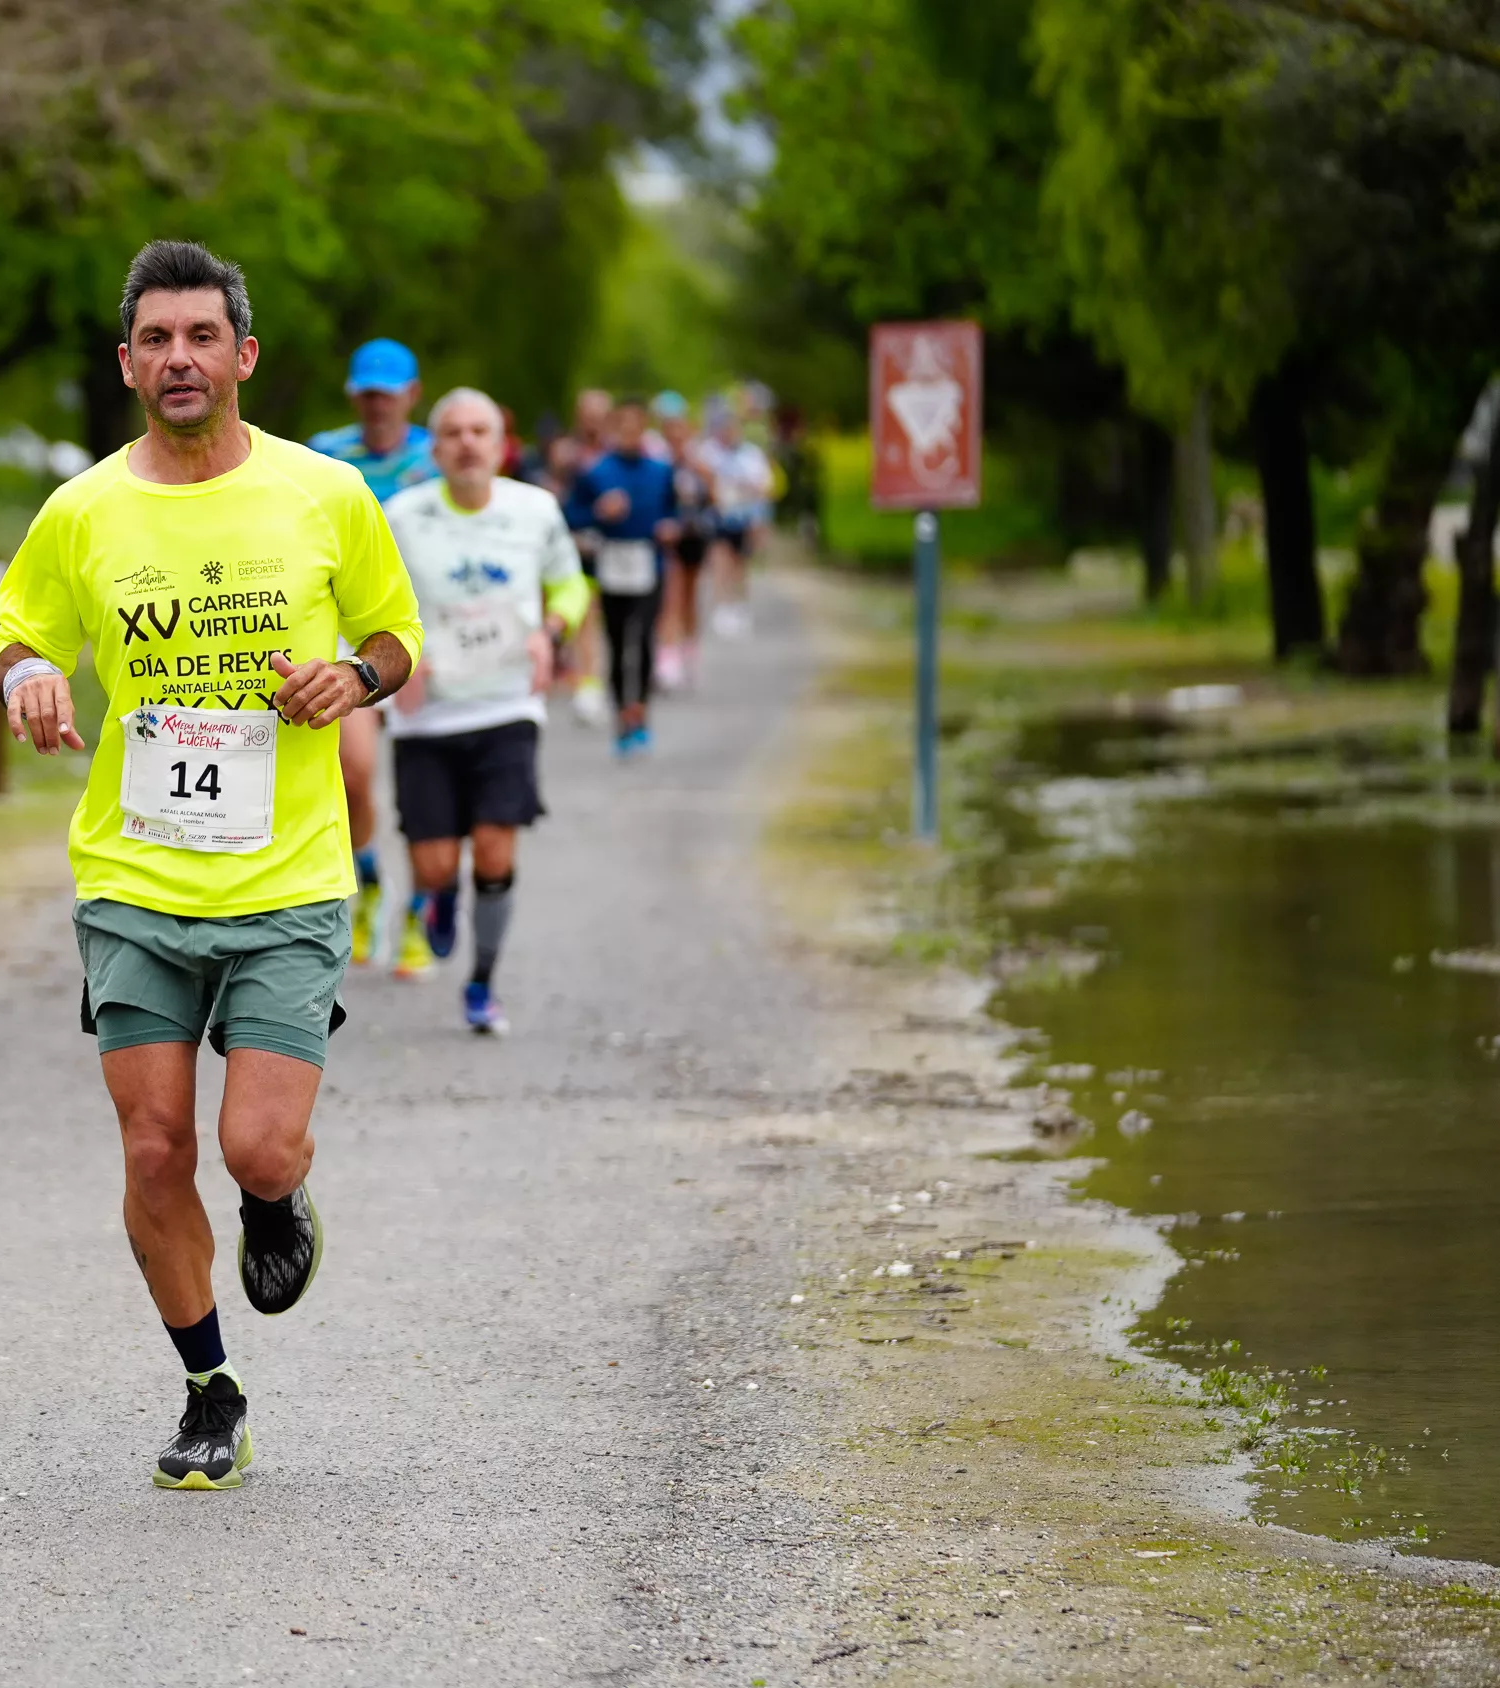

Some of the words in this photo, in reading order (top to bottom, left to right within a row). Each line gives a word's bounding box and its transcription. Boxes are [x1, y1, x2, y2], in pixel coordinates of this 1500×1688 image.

[131, 571, 167, 590] Santaella
[238, 564, 285, 576] DEPORTES
[188, 589, 288, 614] CARRERA
[117, 598, 181, 646] XV
[189, 612, 289, 639] VIRTUAL
[128, 653, 169, 679] DÍA
[176, 655, 211, 677] DE
[161, 680, 233, 695] SANTAELLA
[235, 678, 267, 691] 2021
[177, 731, 229, 750] LUCENA
[169, 760, 222, 801] 14
[160, 808, 179, 816] RAFAEL
[179, 809, 204, 818] ALCARAZ
